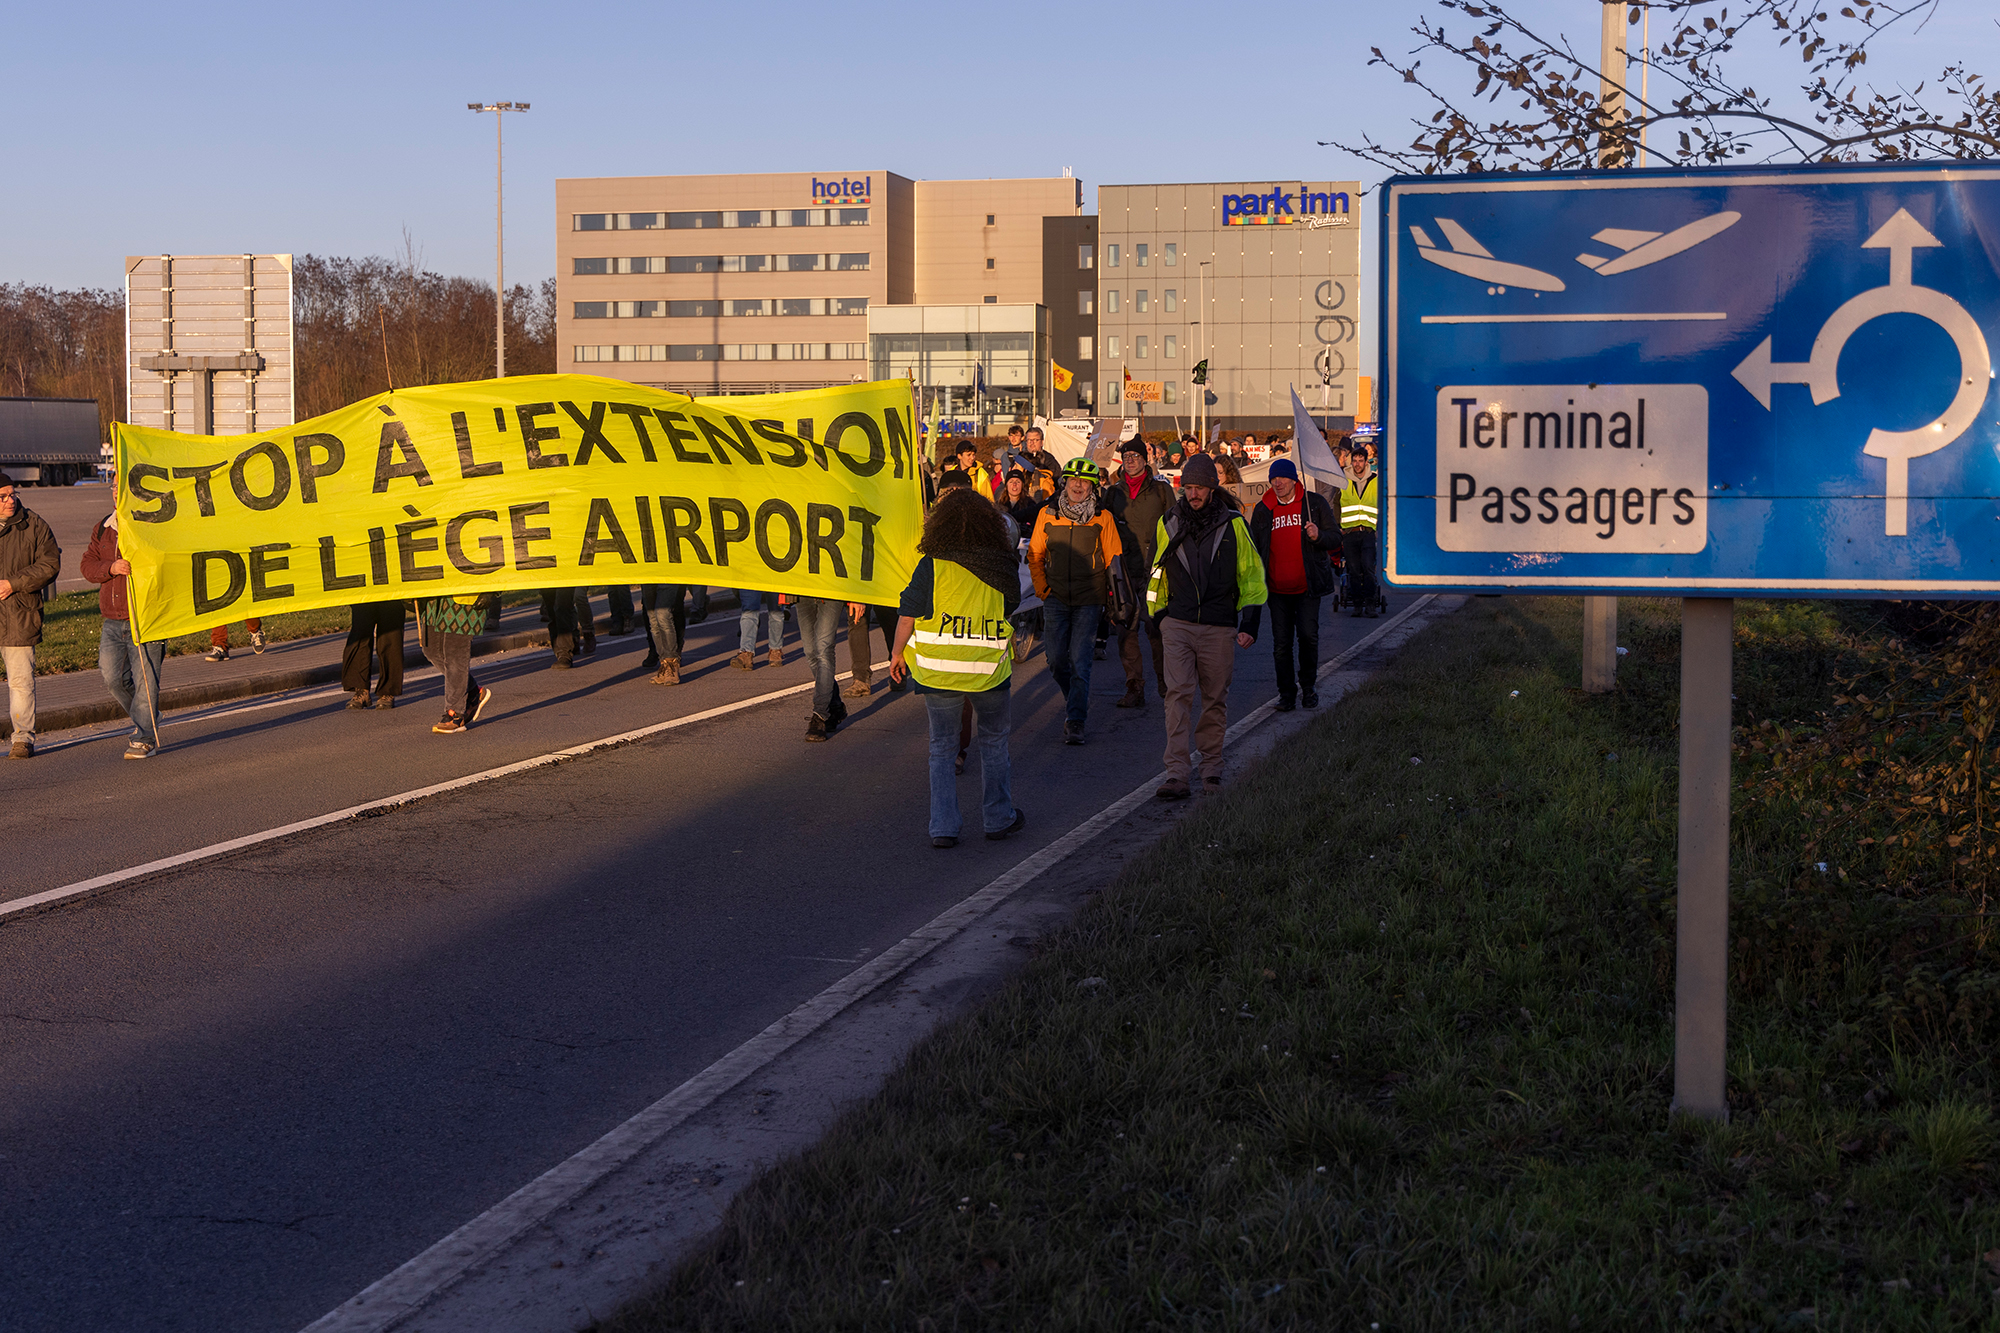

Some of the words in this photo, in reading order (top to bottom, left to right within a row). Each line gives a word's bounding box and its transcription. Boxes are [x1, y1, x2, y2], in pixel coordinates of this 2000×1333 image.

[812, 176, 870, 197] hotel
[1222, 186, 1294, 226] park
[1300, 186, 1349, 214] inn
[1309, 214, 1349, 229] Radisson
[1127, 383, 1156, 391] MERCI
[1451, 398, 1645, 449] Terminal
[128, 432, 346, 523] STOP
[372, 404, 433, 494] À
[451, 400, 913, 480] L'EXTENSION
[1450, 473, 1695, 539] Passagers
[192, 542, 295, 616] DE
[320, 502, 557, 591] LIÈGE
[578, 496, 882, 582] AIRPORT
[939, 612, 1006, 641] POLICE
